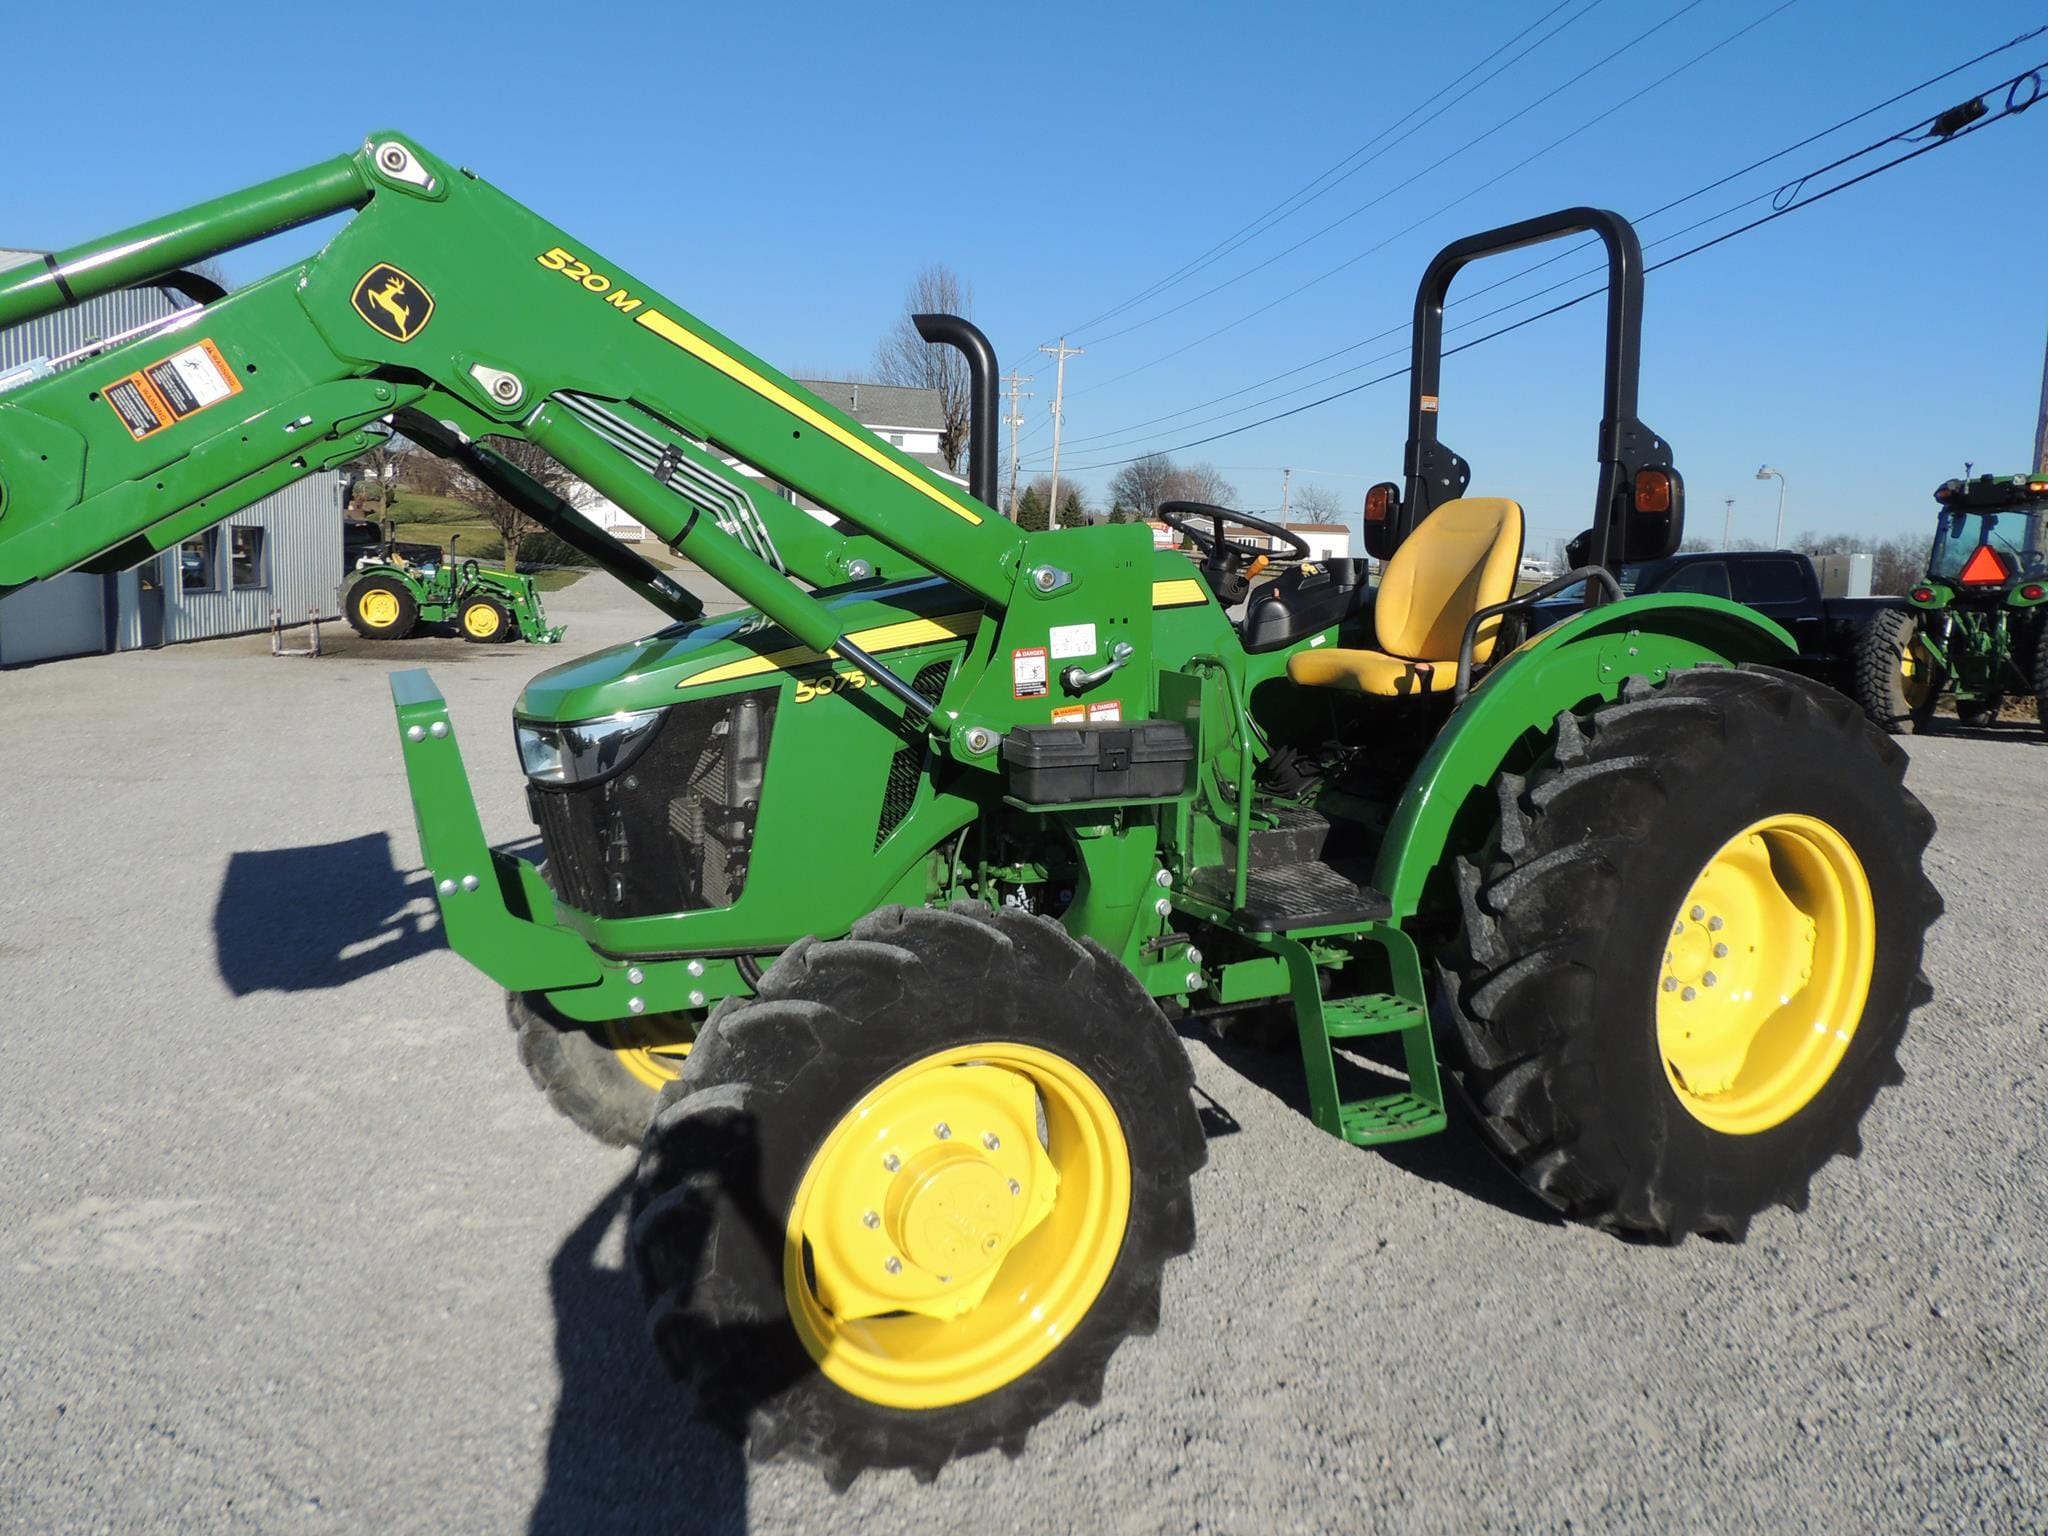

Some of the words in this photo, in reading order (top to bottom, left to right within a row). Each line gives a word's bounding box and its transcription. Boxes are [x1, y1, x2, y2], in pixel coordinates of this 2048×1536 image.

[535, 246, 611, 292] 520
[603, 288, 644, 313] M
[211, 354, 237, 387] WARNING
[142, 388, 167, 421] WARNING
[1021, 649, 1044, 657] DANGER
[794, 669, 879, 704] 5075
